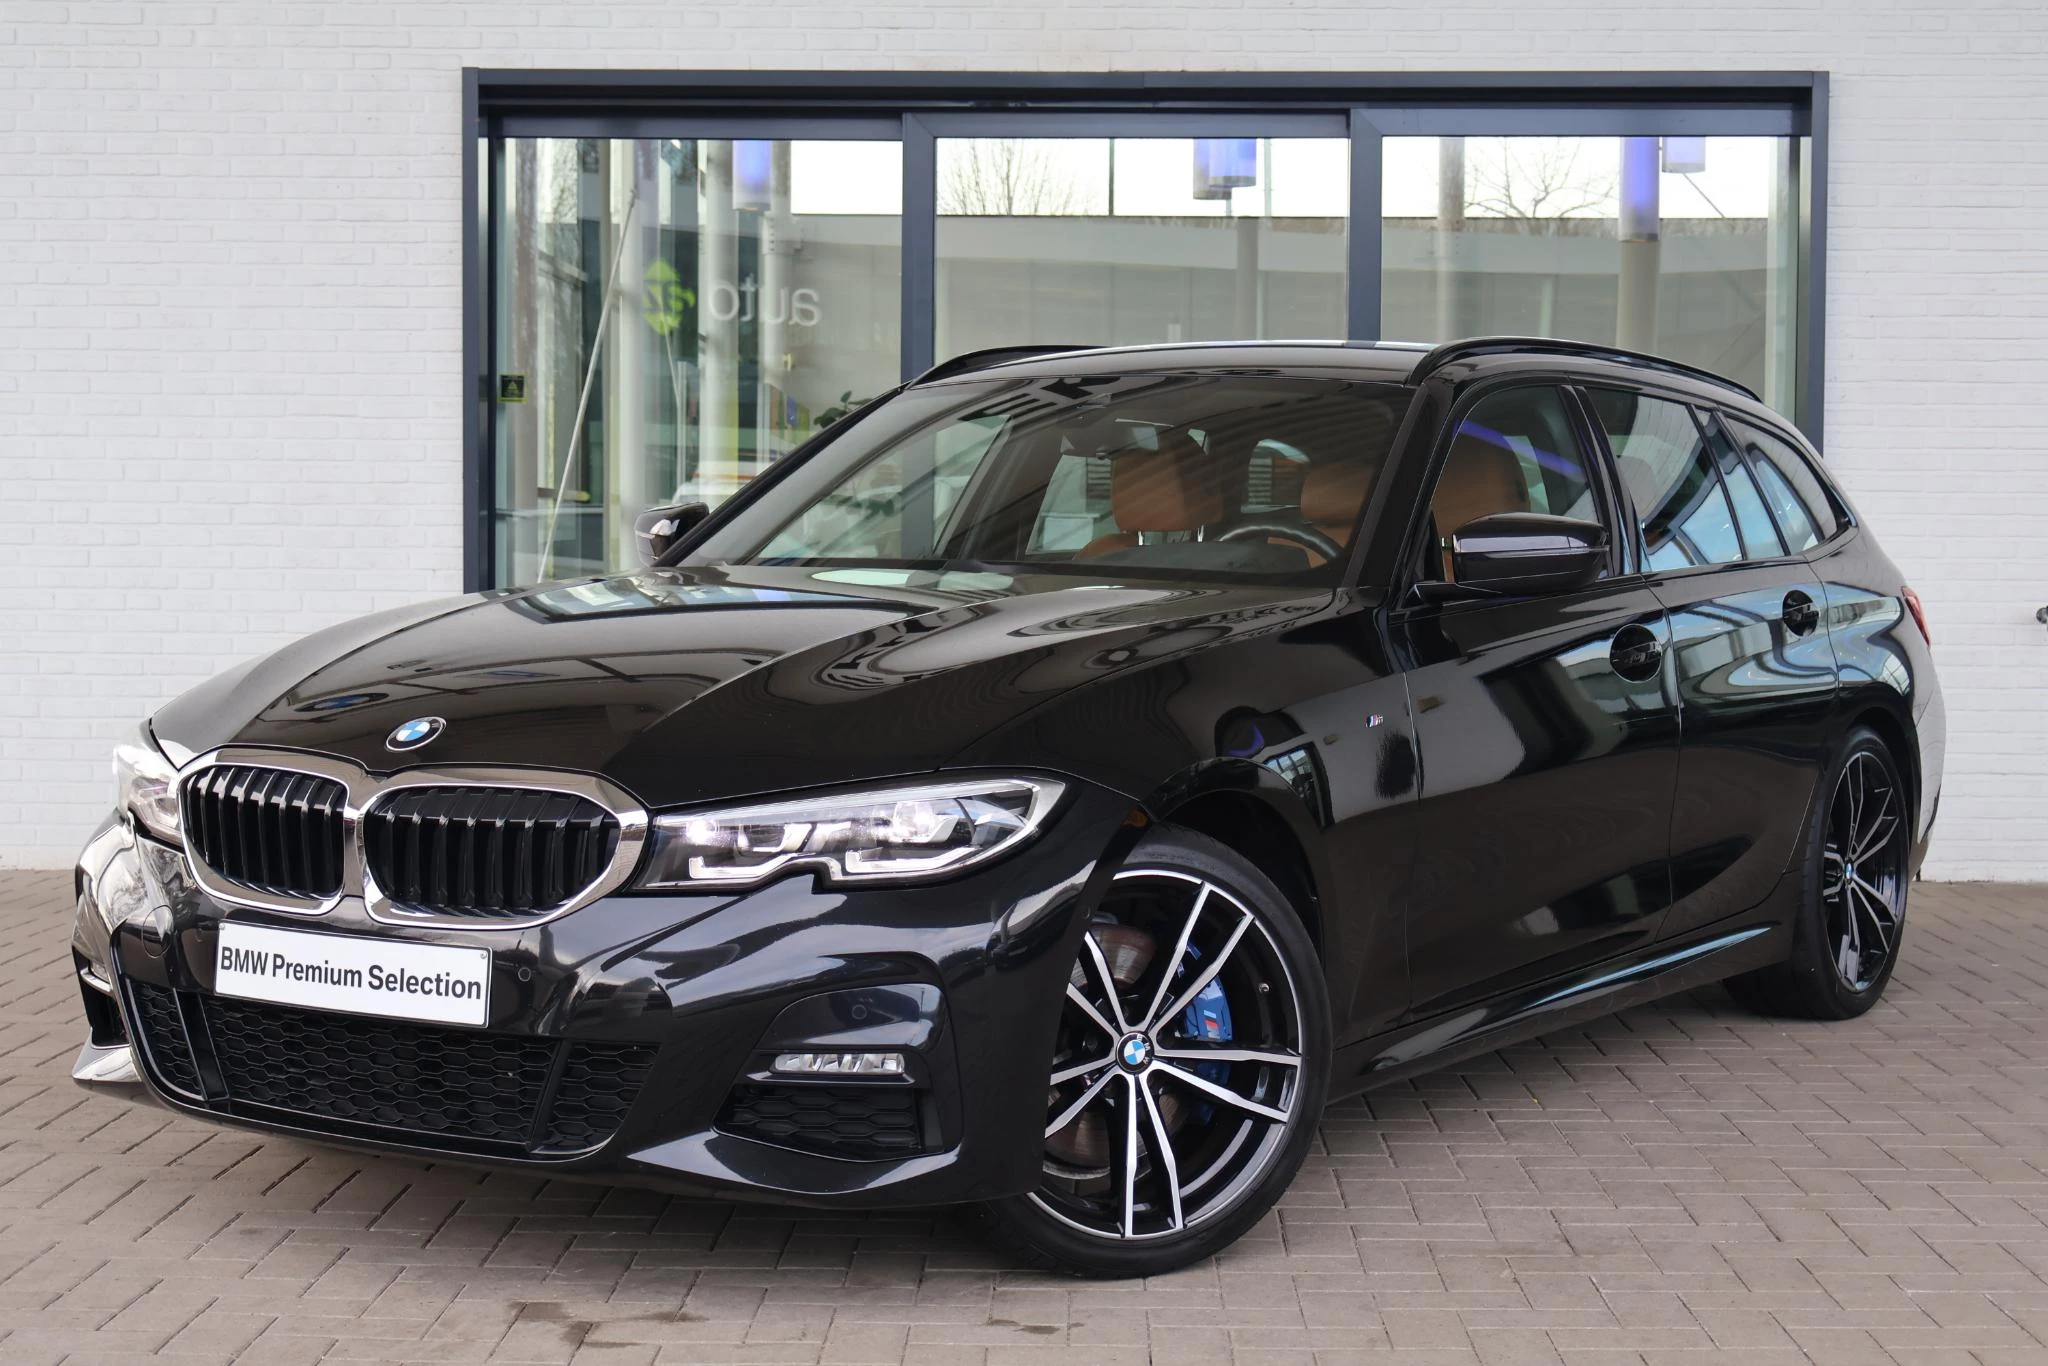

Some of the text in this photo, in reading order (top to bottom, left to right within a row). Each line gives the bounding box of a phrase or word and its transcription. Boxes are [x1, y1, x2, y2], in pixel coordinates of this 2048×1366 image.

[220, 946, 481, 1000] BMW Premium Selection
